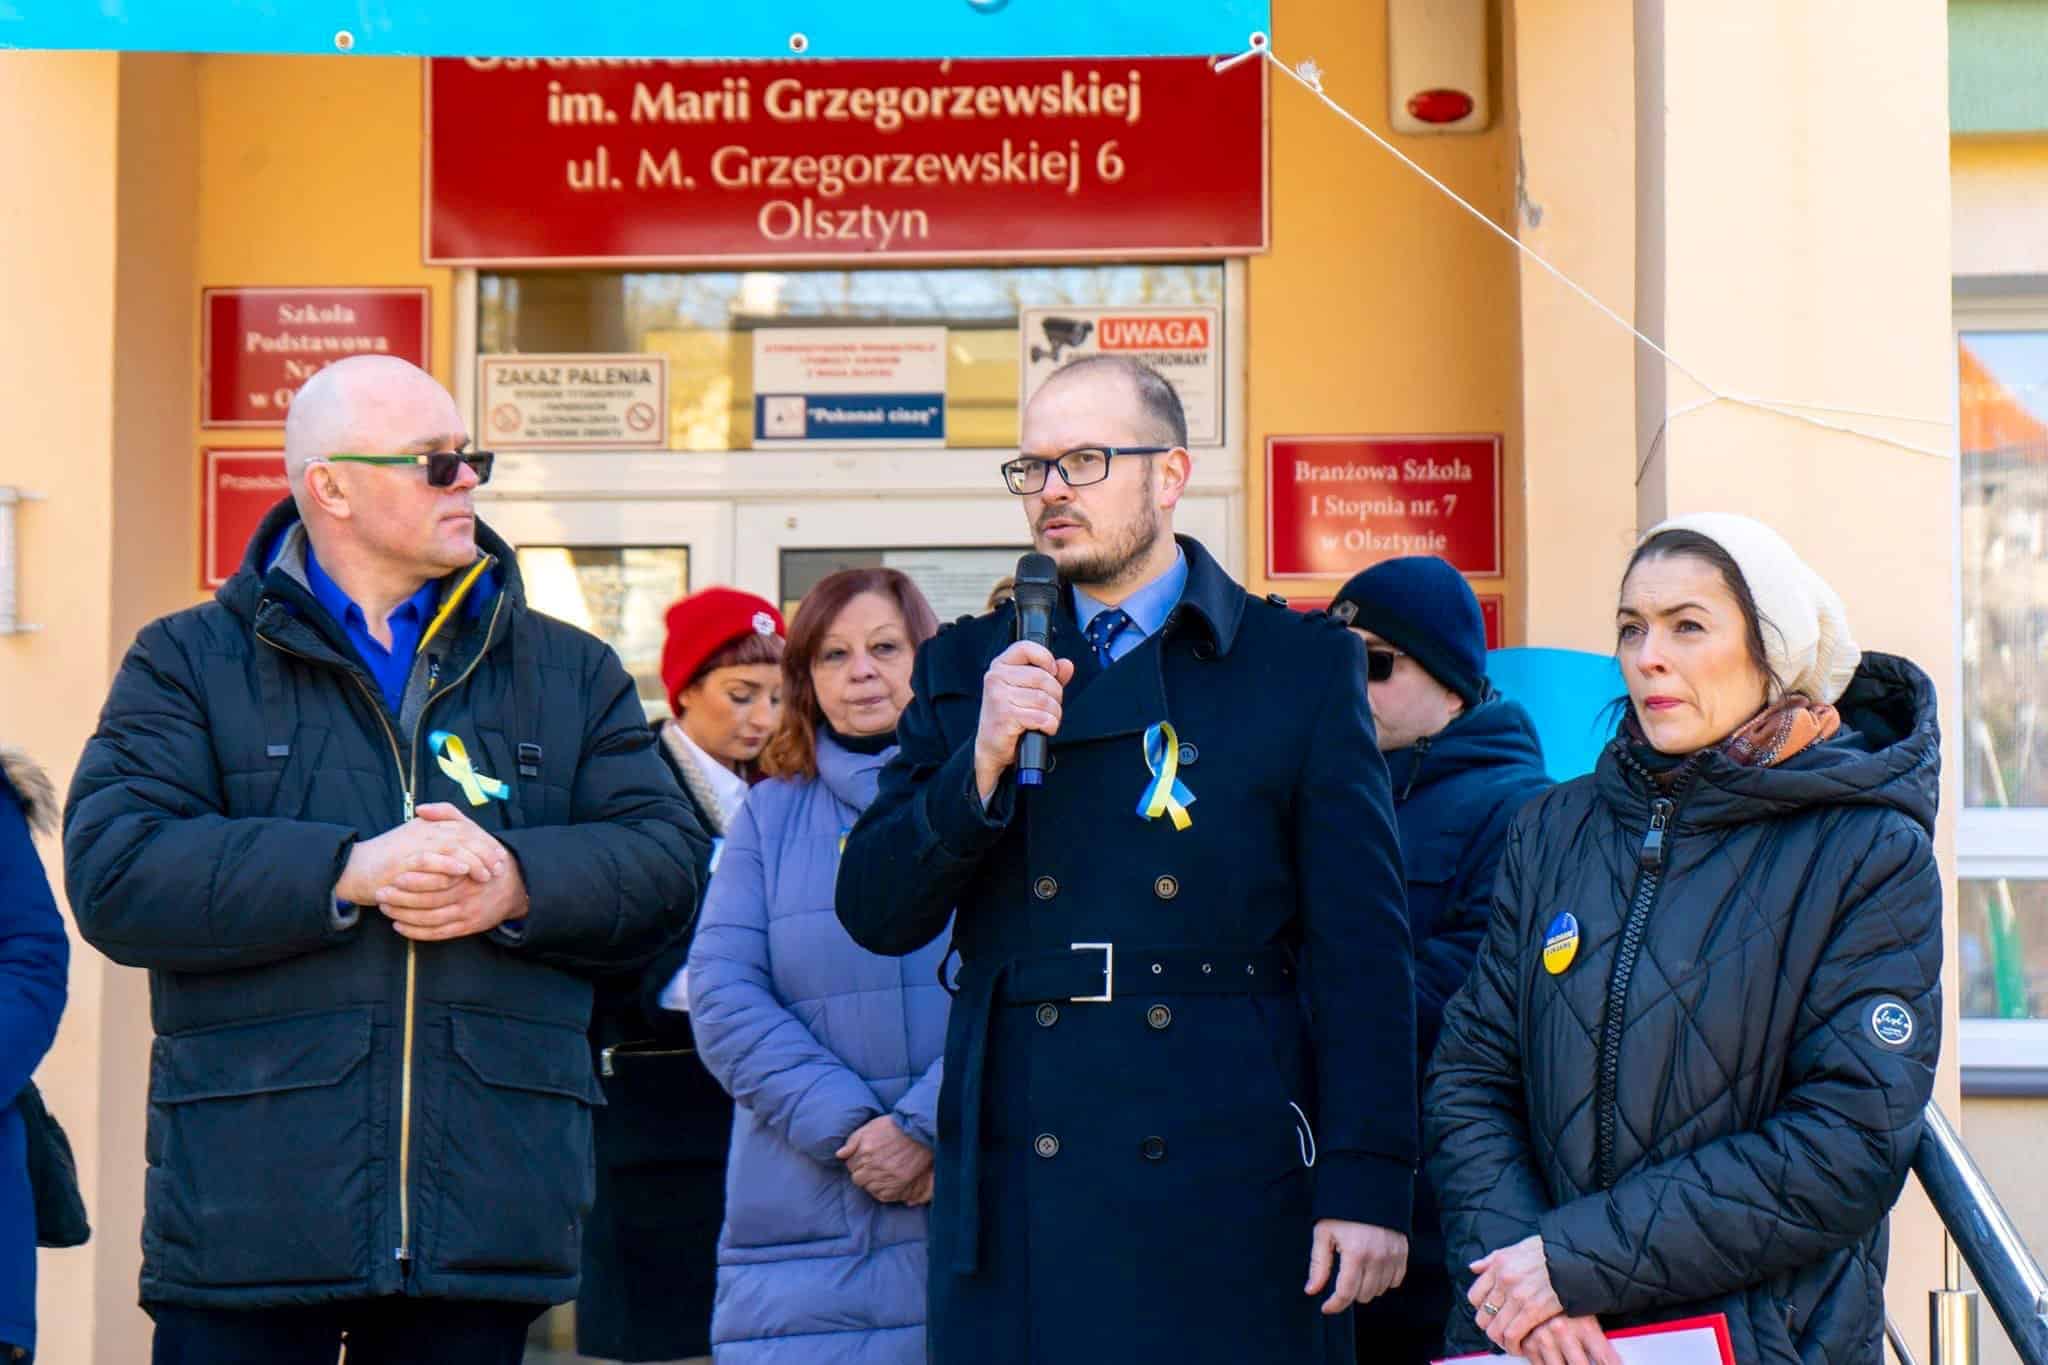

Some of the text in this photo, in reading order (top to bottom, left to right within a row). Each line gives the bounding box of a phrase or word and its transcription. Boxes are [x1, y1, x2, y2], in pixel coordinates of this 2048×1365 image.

[548, 69, 1141, 131] im. Marii Grzegorzewskiej
[566, 138, 1125, 197] ul. M. Grzegorzewskiej 6
[757, 197, 929, 251] Olsztyn
[246, 331, 389, 352] Podstawowa
[1103, 322, 1205, 345] UWAGA
[496, 367, 652, 385] ZAKAZ PALENIA
[1295, 459, 1473, 481] Branżowa Szkoła
[1324, 494, 1406, 522] Stopnia
[1411, 497, 1439, 516] nr.
[1442, 495, 1457, 516] 7
[1319, 529, 1447, 557] w Olsztynie
